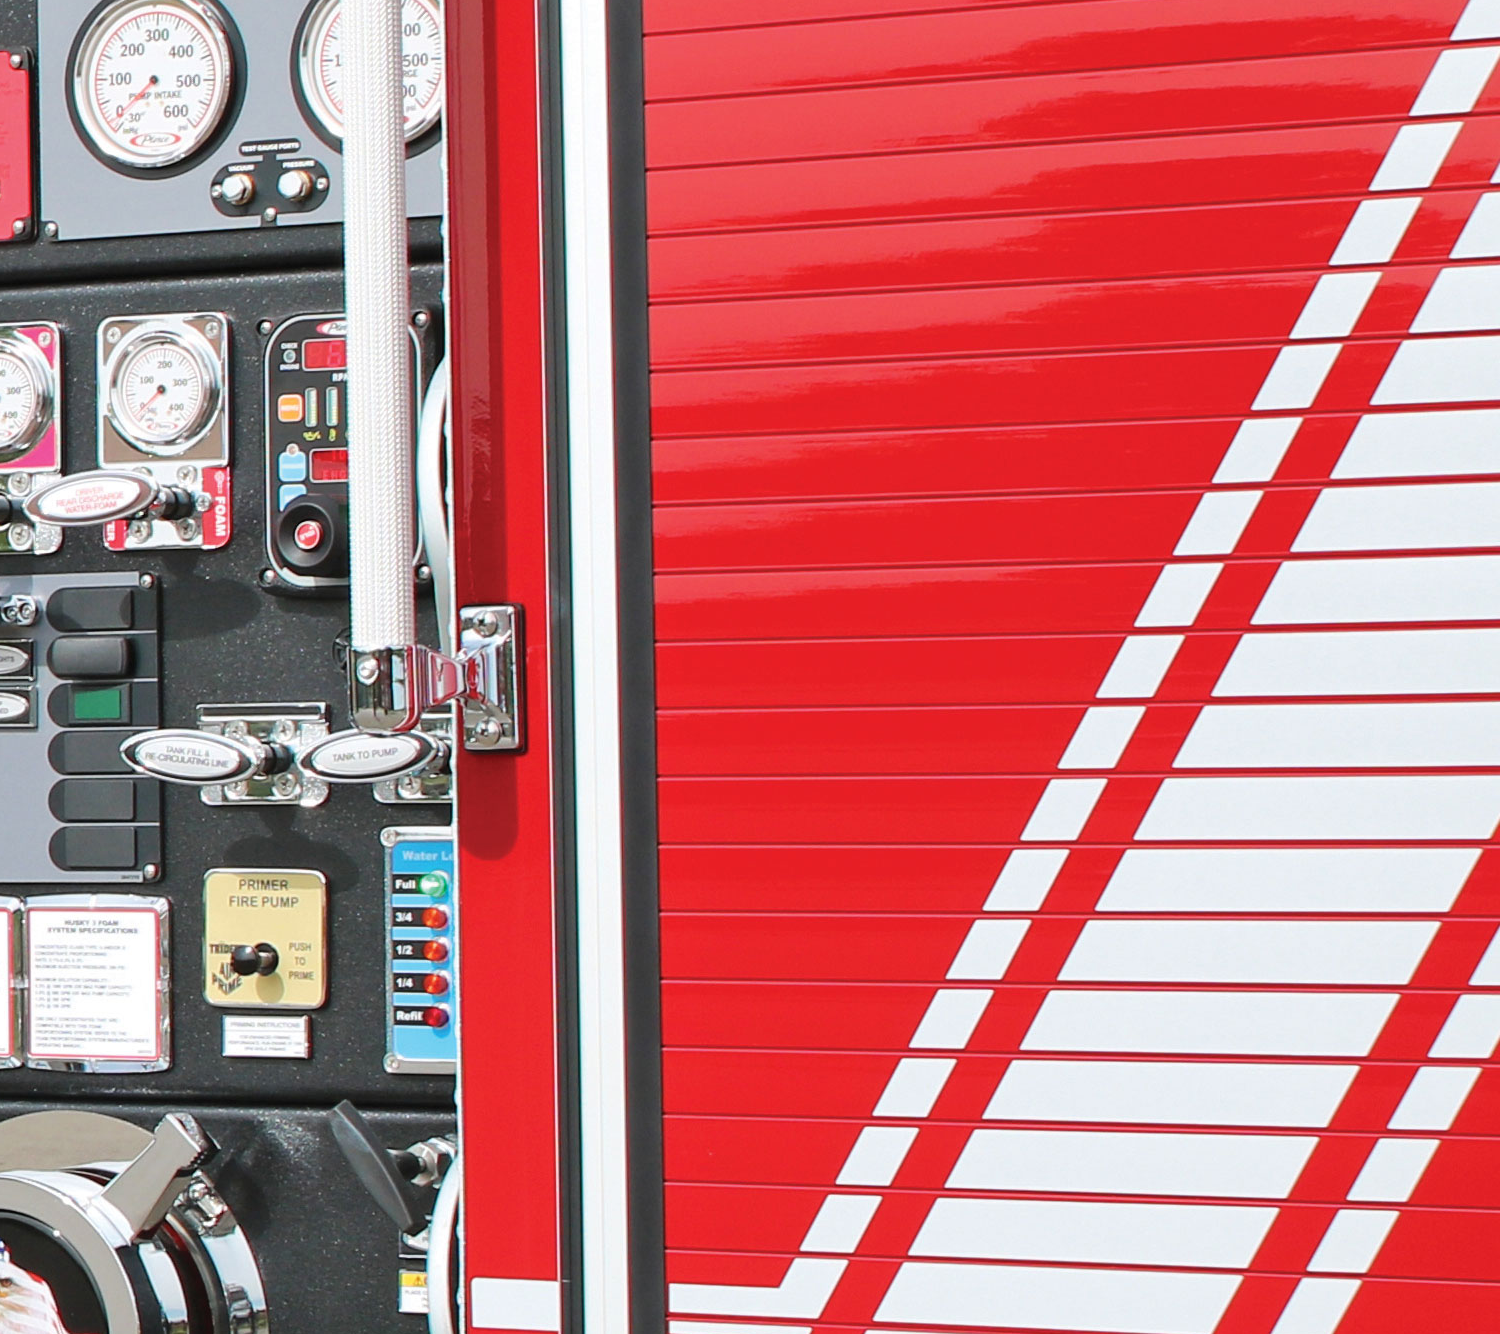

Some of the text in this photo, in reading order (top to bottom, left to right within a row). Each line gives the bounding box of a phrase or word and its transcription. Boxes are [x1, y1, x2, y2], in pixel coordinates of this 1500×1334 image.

[145, 28, 170, 43] 300
[120, 43, 145, 57] 200
[169, 44, 194, 58] 400
[403, 52, 429, 67] 500
[108, 72, 132, 86] 100
[176, 74, 201, 88] 500
[154, 90, 182, 99] INTAKE
[116, 105, 124, 117] 0
[164, 105, 189, 118] 600
[241, 145, 258, 153] TEST
[280, 142, 299, 150] PORTS
[283, 160, 315, 168] PRESSURE
[76, 486, 104, 497] DRIVER
[56, 491, 124, 508] REAR DISCHARGE
[65, 500, 117, 513] WATER-FOAM
[215, 496, 227, 537] FOAM
[166, 746, 203, 756] TANK FILL
[332, 747, 398, 762] TANK TO PUMP
[145, 752, 229, 769] RE-CIRCULATING LINE
[402, 849, 437, 863] Water
[239, 879, 289, 890] PRIMER
[395, 879, 417, 889] Full
[229, 896, 299, 908] FIRE PUMP
[64, 919, 90, 927] HUSKY
[395, 913, 413, 923] 3/4
[78, 927, 139, 935] SPECIFICATIONS
[288, 942, 312, 952] PUSH
[396, 945, 413, 955] 1/2
[294, 956, 306, 966] TO
[288, 971, 315, 981] PRIME
[211, 973, 242, 996] PRIME
[396, 978, 414, 988] 1/4
